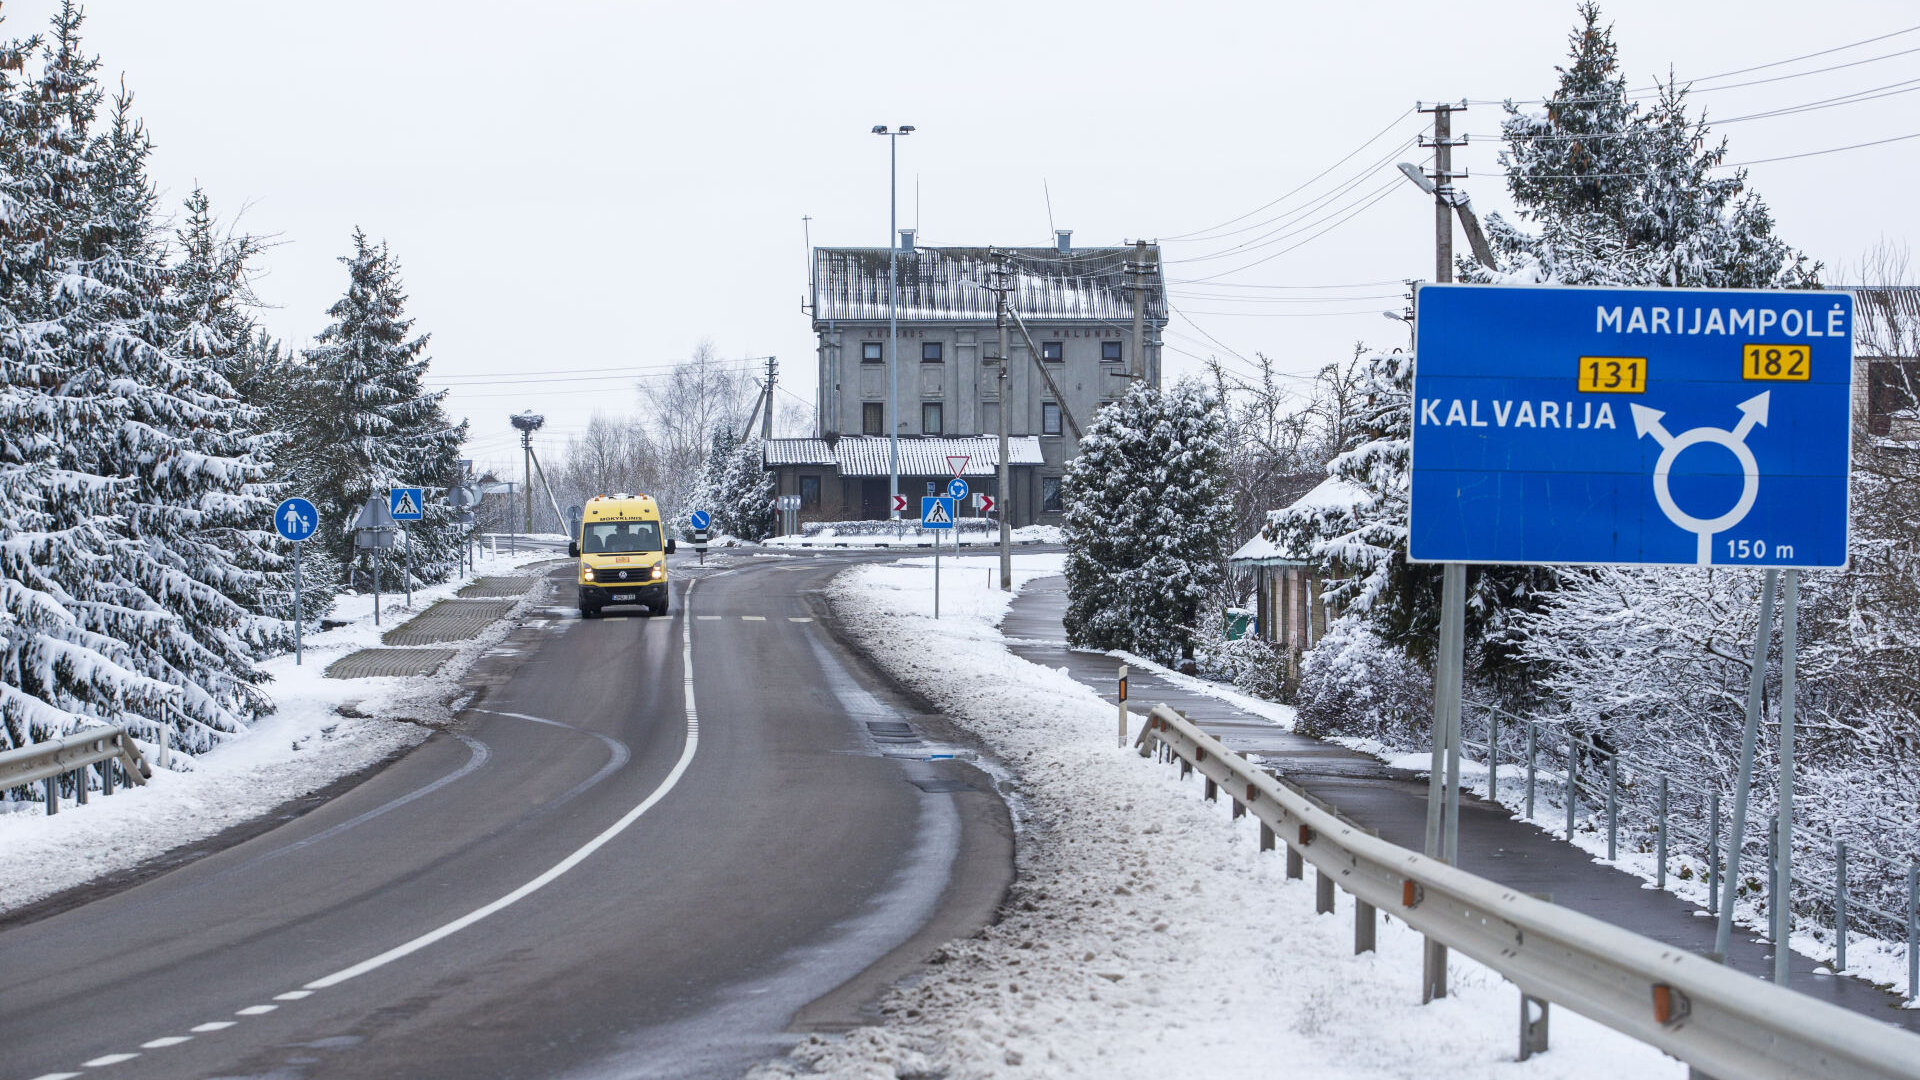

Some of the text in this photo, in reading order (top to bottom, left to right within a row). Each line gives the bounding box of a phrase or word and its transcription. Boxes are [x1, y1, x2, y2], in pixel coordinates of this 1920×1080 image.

[1597, 303, 1846, 337] MARIJAMPOLĖ
[1588, 361, 1639, 389] 131
[1750, 349, 1804, 376] 182
[1420, 398, 1616, 429] KALVARIJA
[1727, 539, 1794, 559] 150 m
